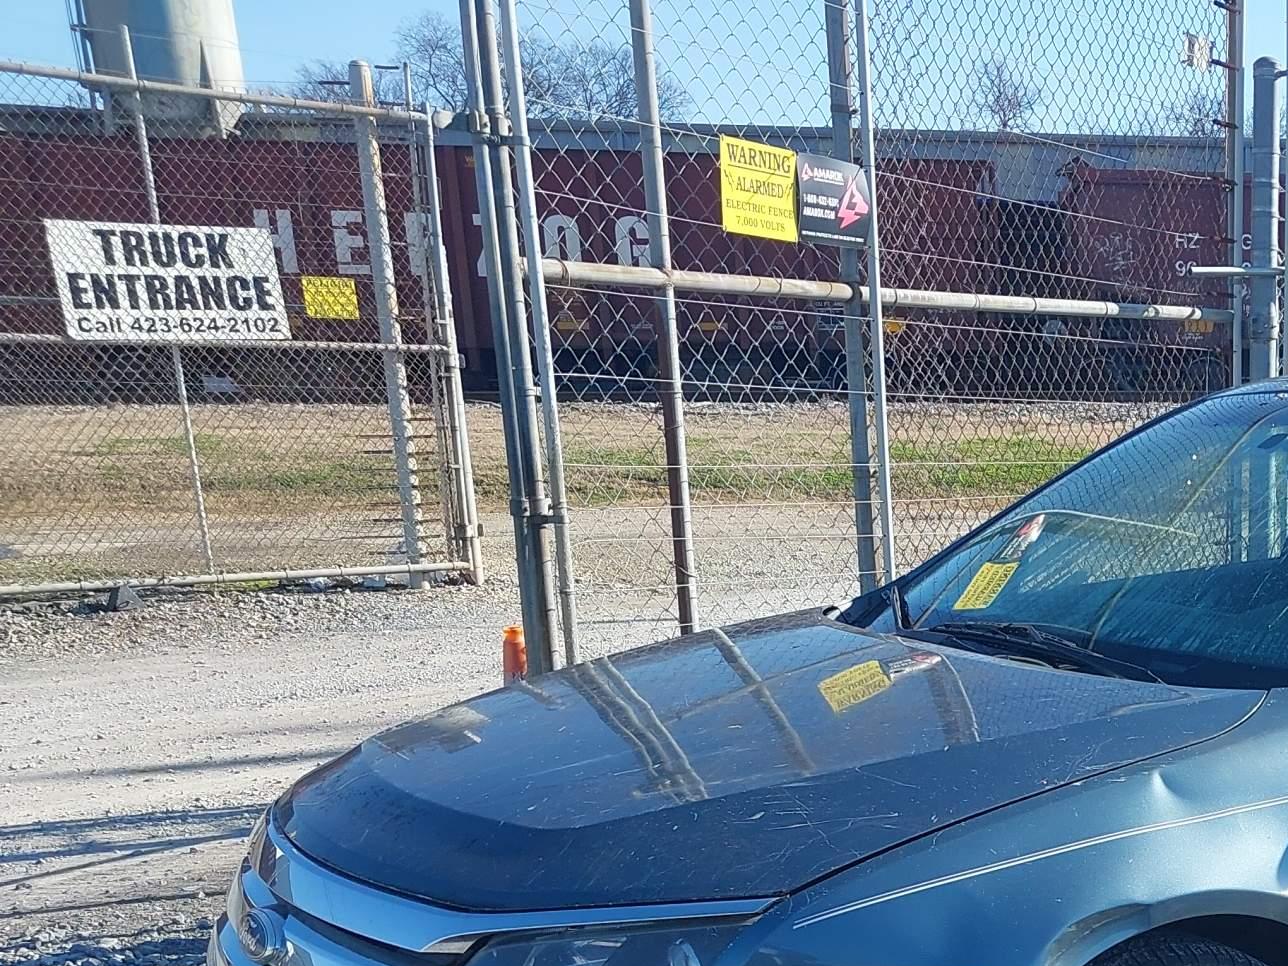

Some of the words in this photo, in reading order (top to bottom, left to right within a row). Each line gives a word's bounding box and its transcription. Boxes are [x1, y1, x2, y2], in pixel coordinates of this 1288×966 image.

[727, 143, 791, 174] WARNING
[814, 167, 844, 183] AMAROK
[736, 176, 784, 198] ALARMED
[726, 198, 766, 214] ELECTRIC
[768, 207, 794, 219] FENCE
[736, 216, 758, 228] 7,000
[760, 219, 786, 232] VOLTS
[92, 229, 234, 269] TRUCK
[253, 208, 652, 277] HEROG
[65, 272, 276, 311] ENTRANCE
[77, 316, 123, 333] Call
[130, 317, 281, 334] 423-624-2102
